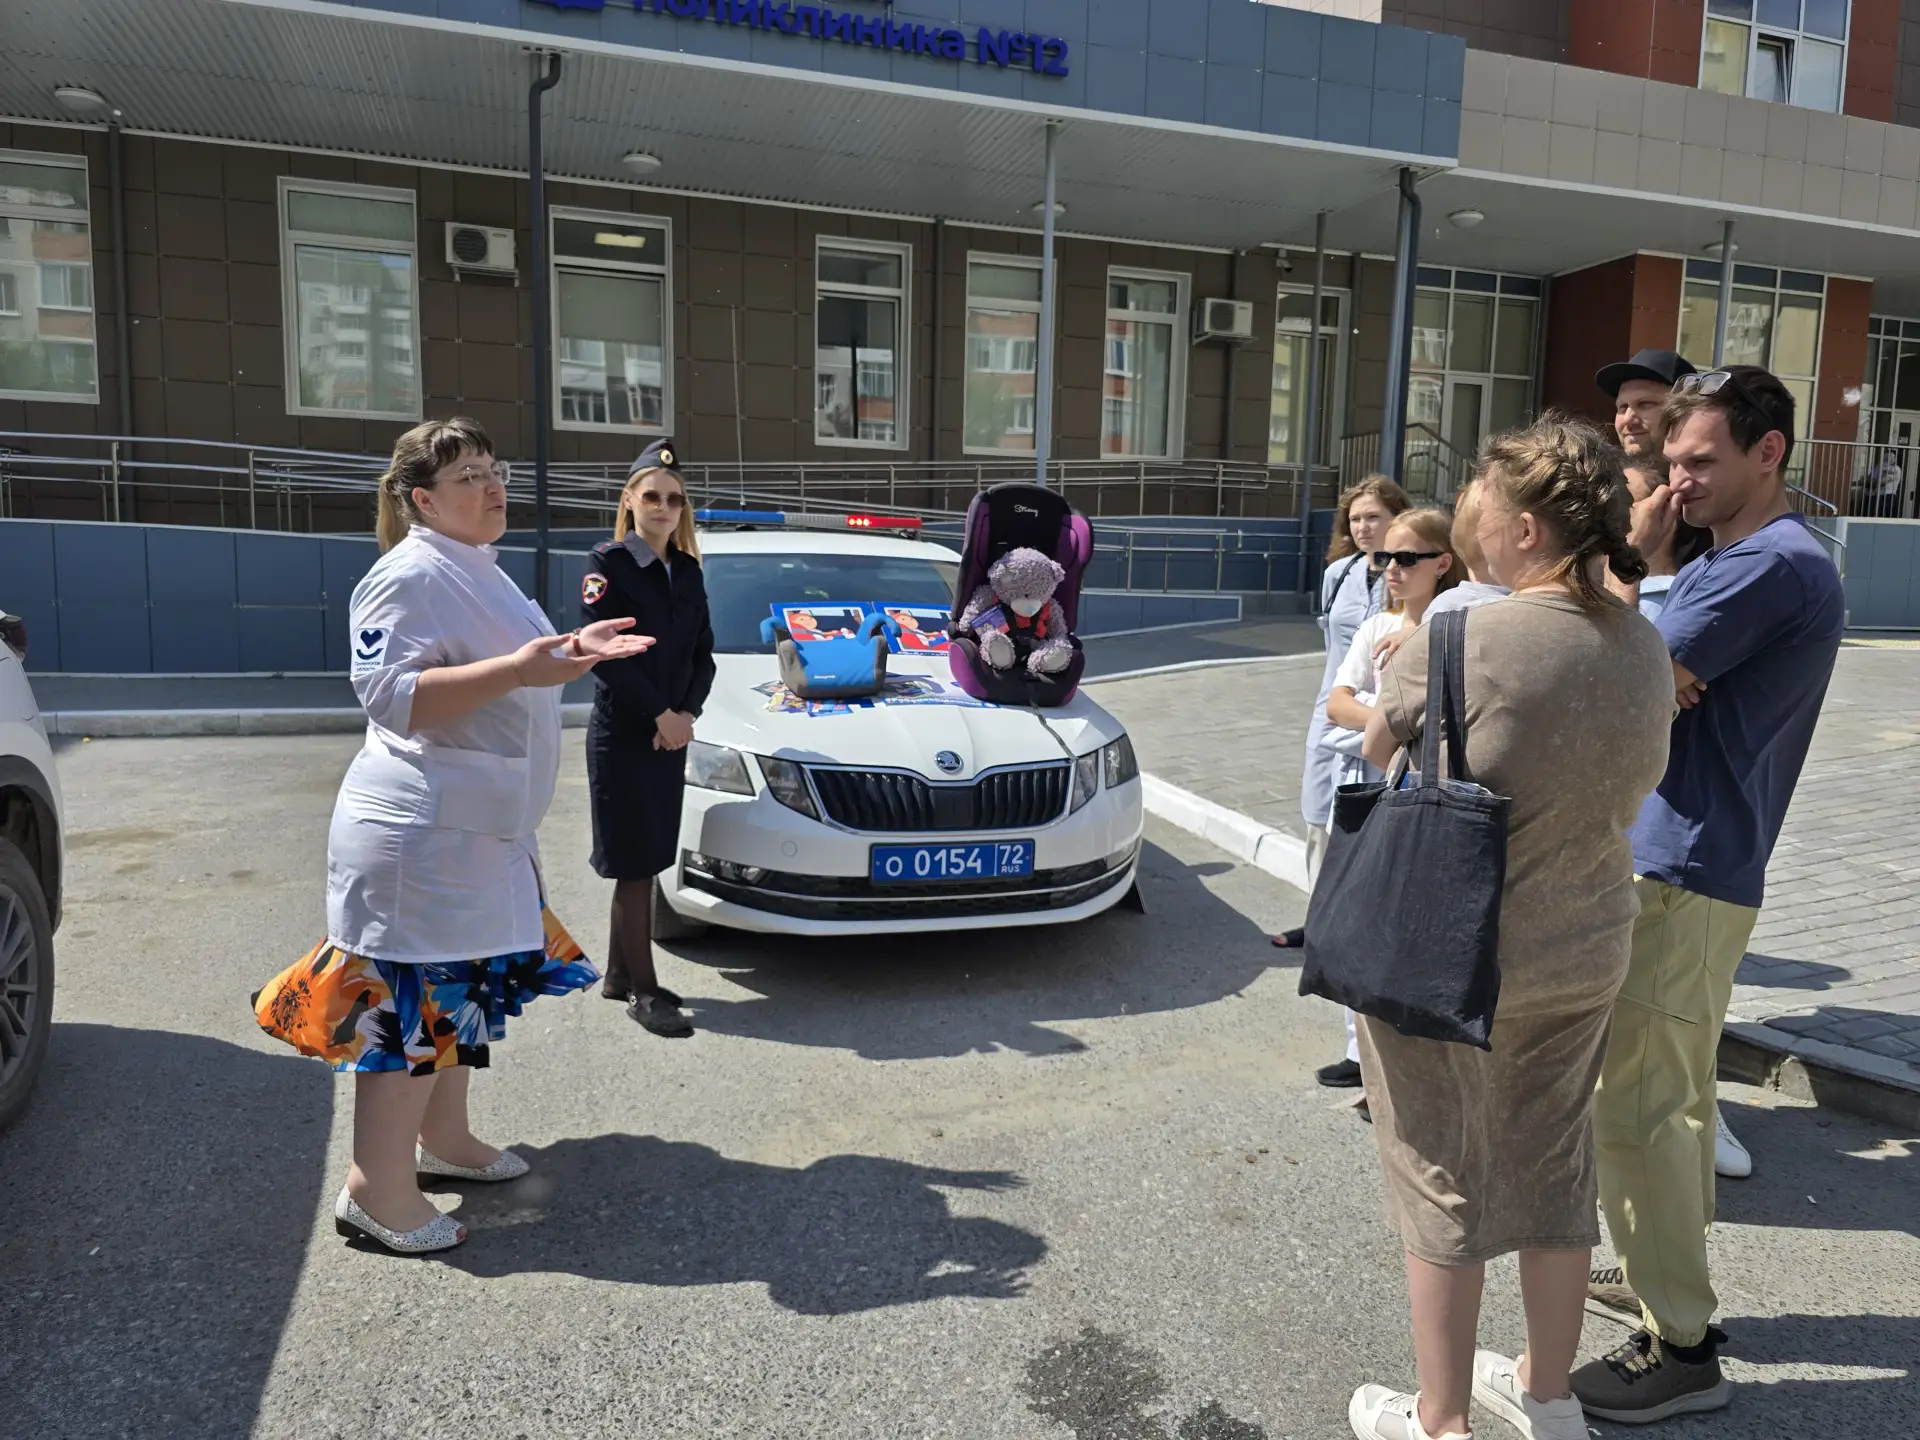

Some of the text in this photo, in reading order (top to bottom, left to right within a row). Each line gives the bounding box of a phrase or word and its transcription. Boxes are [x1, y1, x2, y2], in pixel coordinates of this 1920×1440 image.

[977, 26, 1069, 77] №12
[914, 848, 982, 876] 0154
[999, 844, 1024, 865] 72
[1001, 865, 1020, 873] RUS
